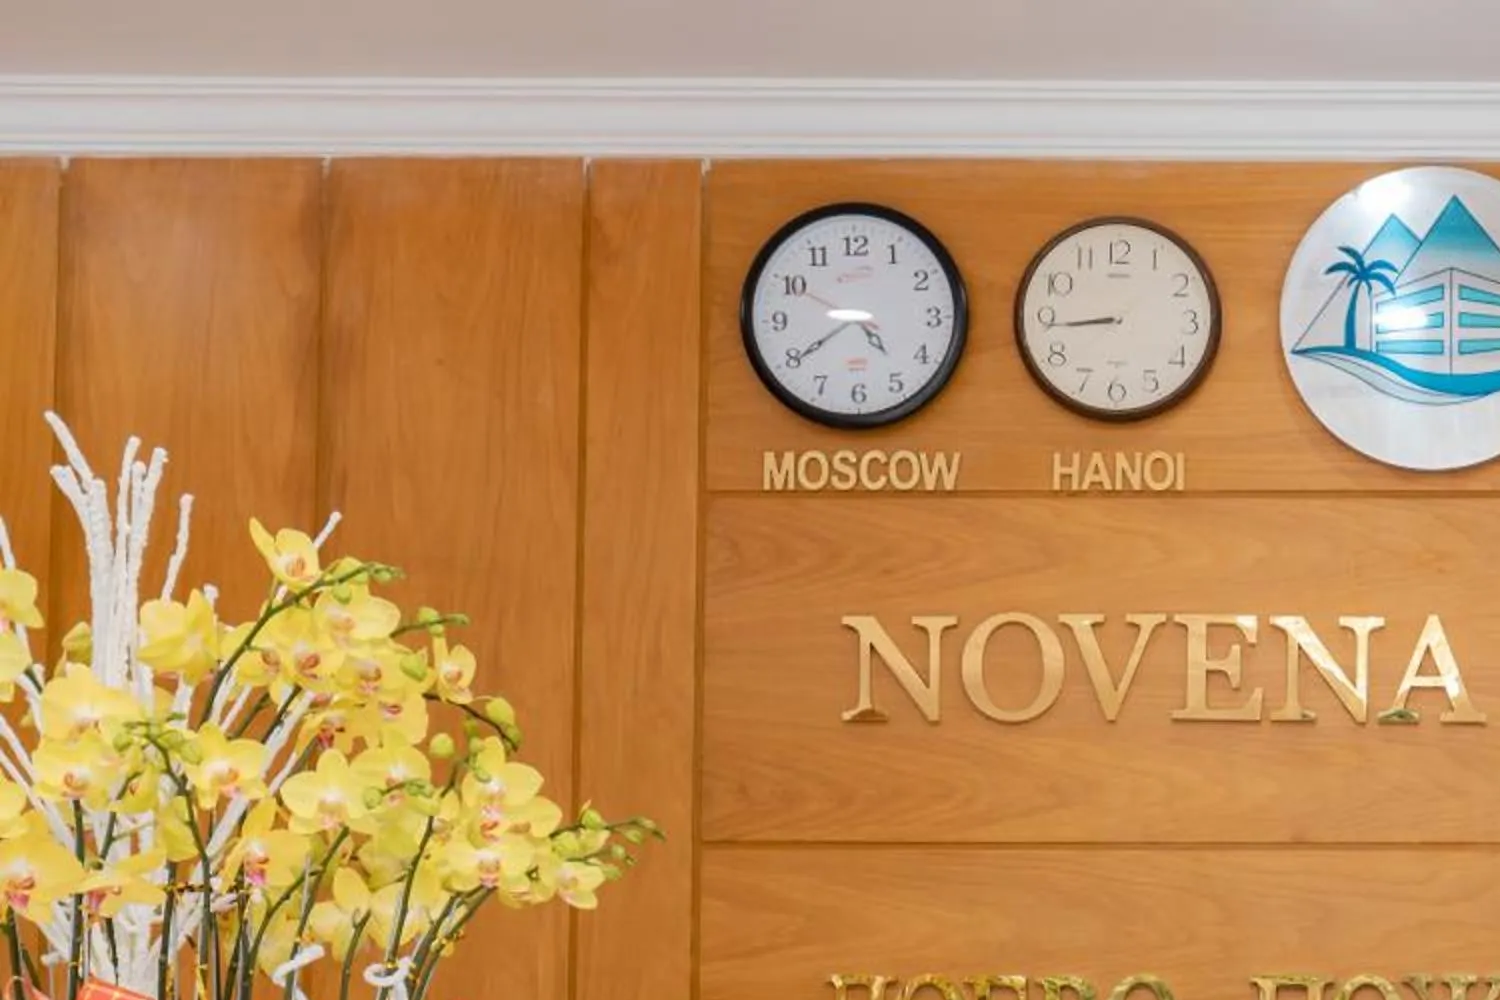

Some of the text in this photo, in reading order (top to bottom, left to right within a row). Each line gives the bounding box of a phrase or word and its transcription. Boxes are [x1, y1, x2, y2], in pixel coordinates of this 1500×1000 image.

[809, 246, 828, 266] 11
[842, 236, 869, 256] 12
[888, 244, 897, 264] 1
[1109, 240, 1130, 265] 12
[1077, 246, 1092, 269] 11
[1152, 249, 1158, 270] 1
[784, 275, 806, 295] 10
[914, 270, 929, 291] 2
[1048, 271, 1073, 296] 10
[1173, 274, 1189, 297] 2
[772, 312, 788, 331] 9
[926, 307, 942, 327] 3
[1037, 306, 1055, 329] 9
[1183, 310, 1199, 335] 3
[785, 349, 801, 368] 8
[914, 344, 929, 364] 4
[1048, 341, 1066, 366] 8
[1168, 346, 1185, 368] 4
[814, 376, 828, 395] 7
[889, 372, 903, 393] 5
[1077, 368, 1093, 392] 7
[1108, 379, 1126, 401] 6
[1143, 370, 1159, 393] 5
[852, 384, 866, 403] 6
[763, 451, 960, 491] MOSCOW
[1053, 451, 1185, 491] HANOI
[840, 612, 1487, 724] NOVENA
